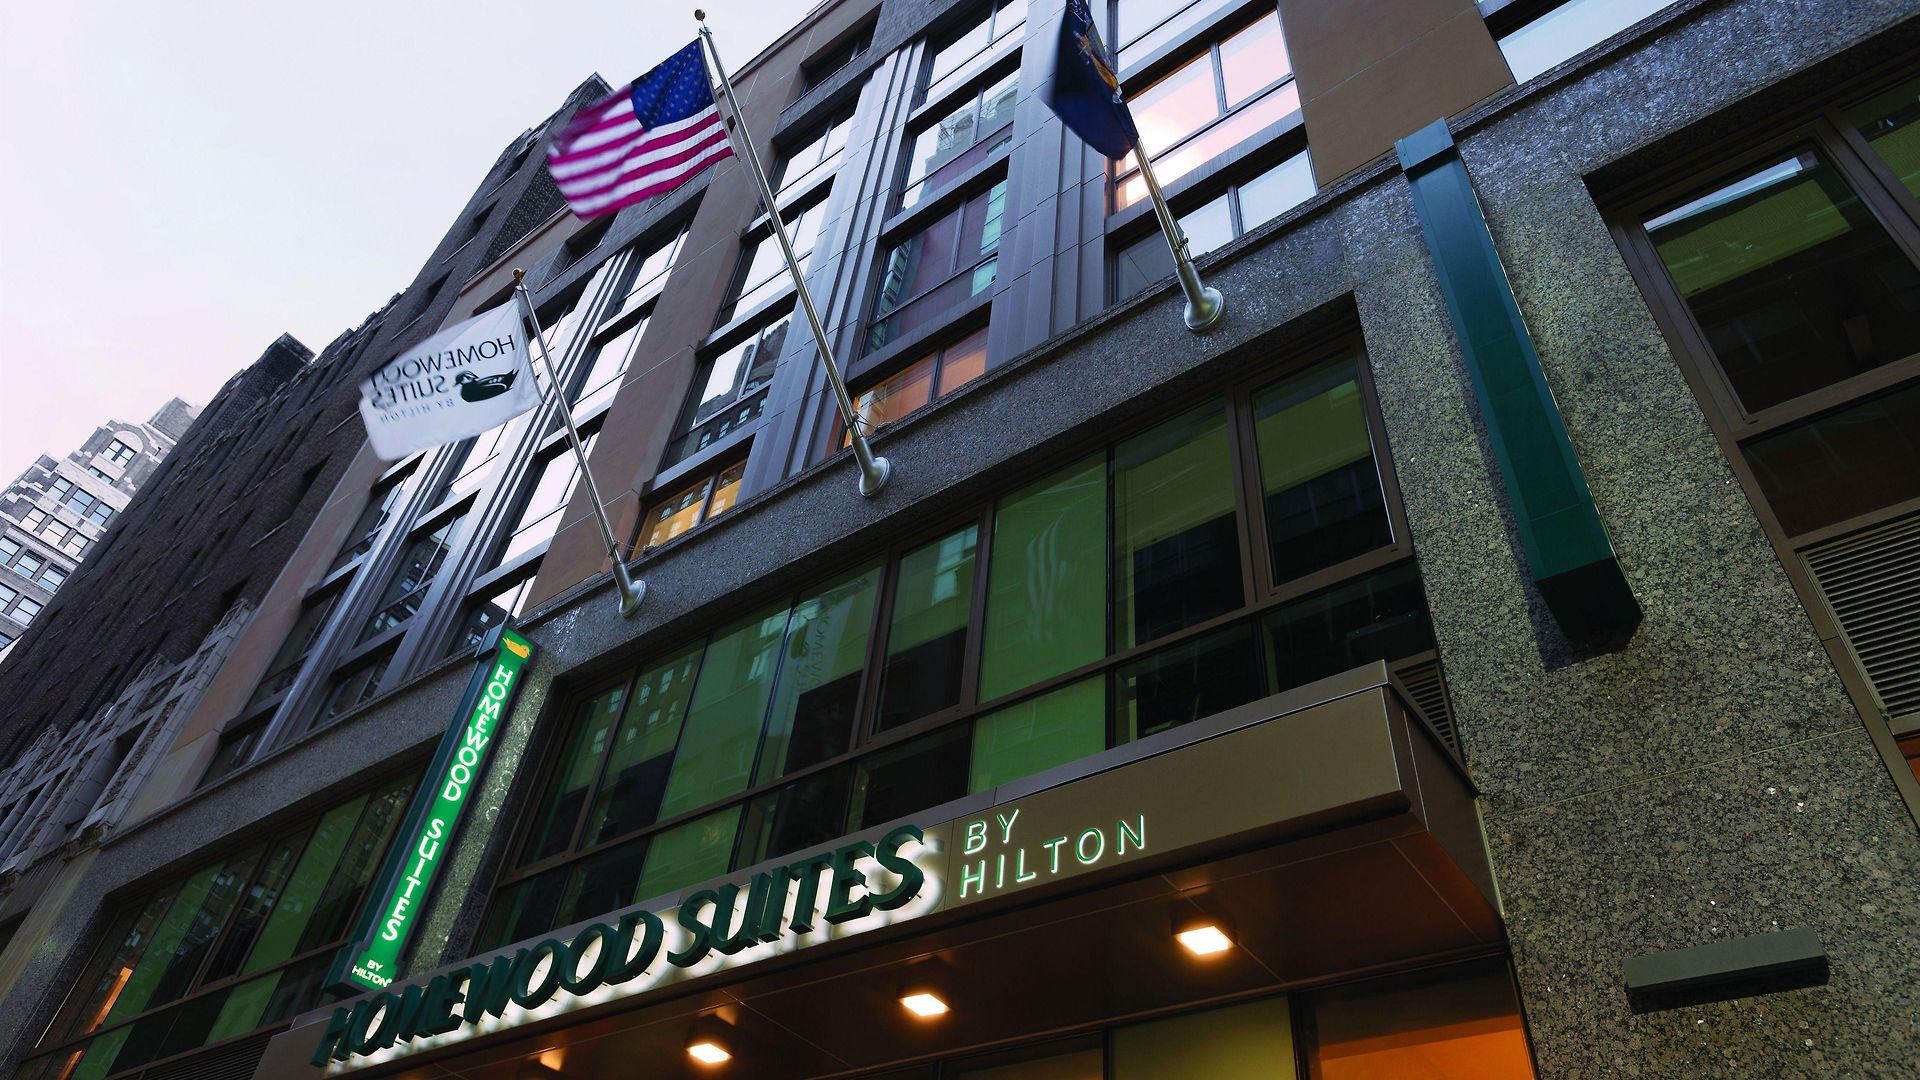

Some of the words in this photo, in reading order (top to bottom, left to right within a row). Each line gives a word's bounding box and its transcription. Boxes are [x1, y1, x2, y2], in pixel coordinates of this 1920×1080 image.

[442, 664, 514, 801] HOMEWOOD
[959, 814, 1146, 899] HILTON
[966, 809, 1020, 855] BY
[381, 818, 445, 942] SUITES
[311, 910, 664, 1067] HOMEWOOD
[667, 824, 926, 968] SUITES
[351, 965, 392, 988] HILTON
[366, 959, 383, 970] BY
